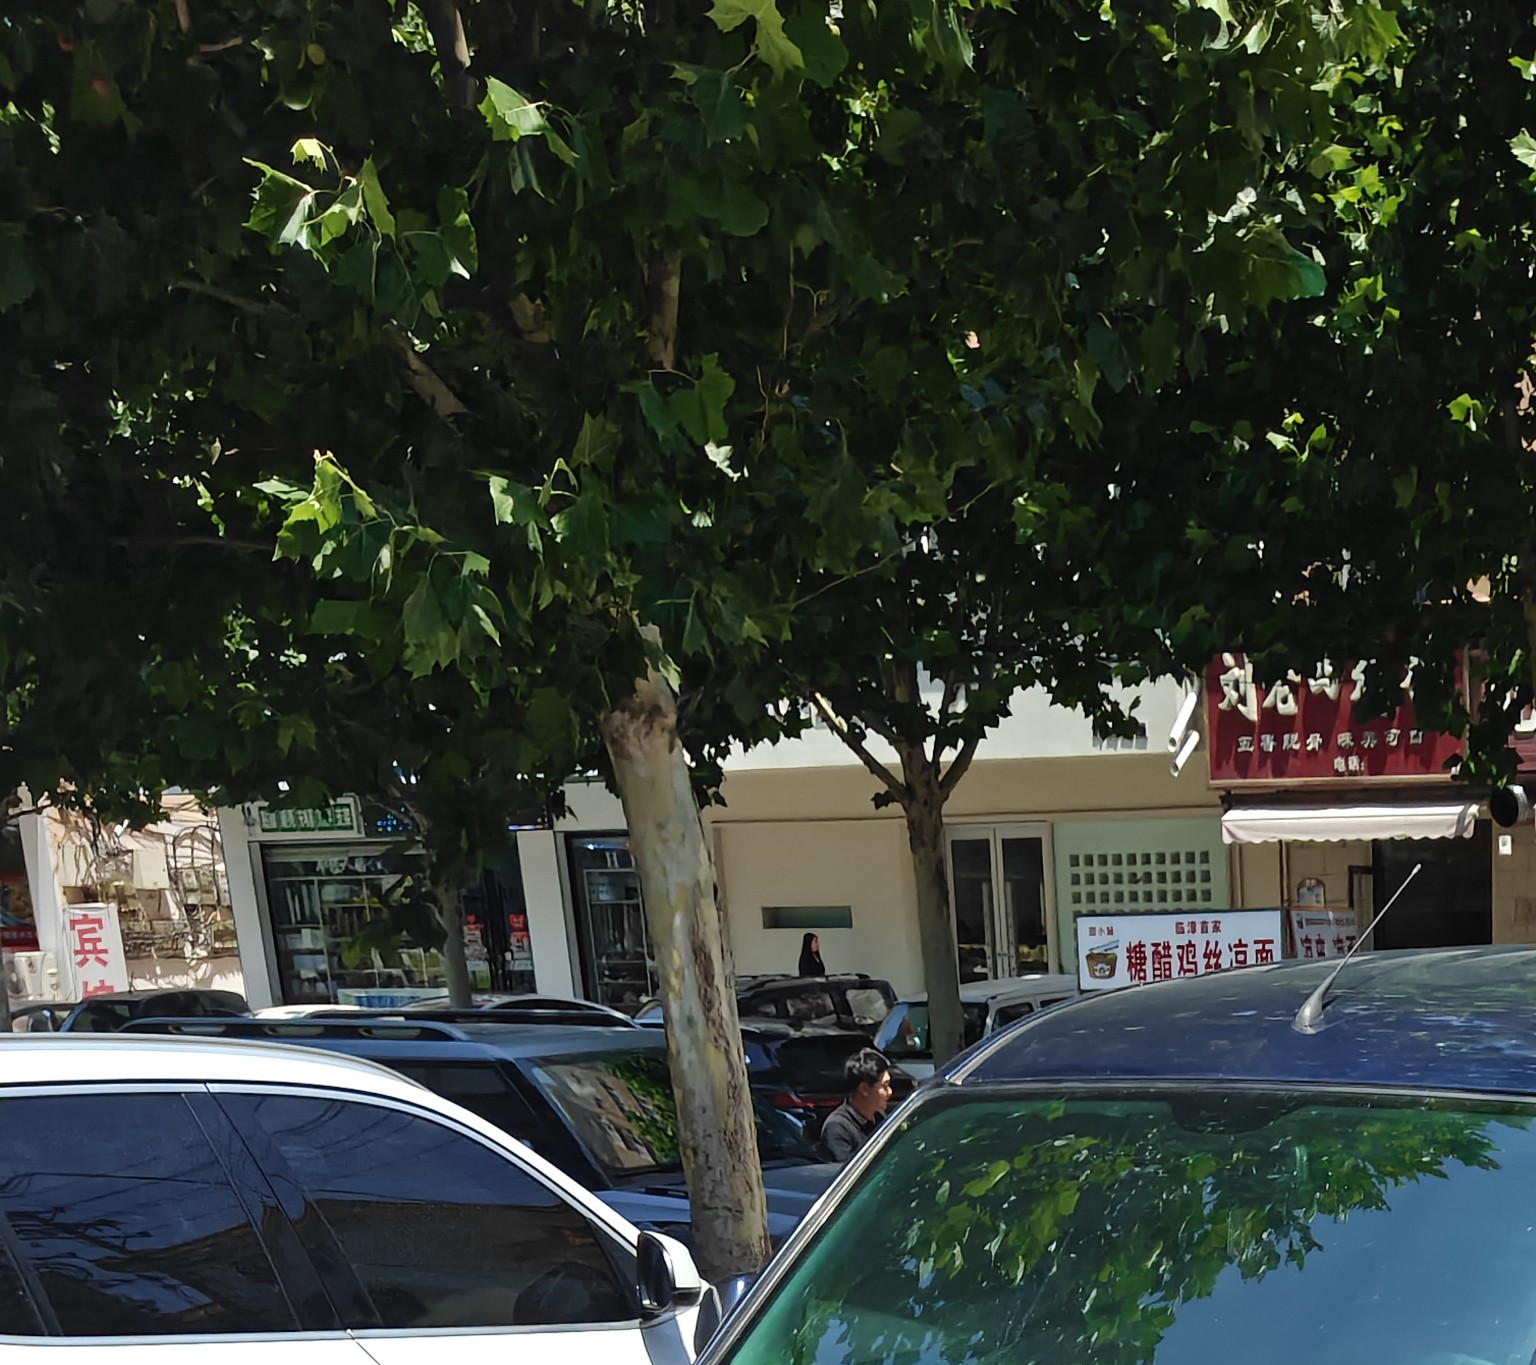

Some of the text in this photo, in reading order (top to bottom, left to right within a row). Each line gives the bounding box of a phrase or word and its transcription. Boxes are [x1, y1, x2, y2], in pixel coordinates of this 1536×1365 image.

[1125, 939, 1275, 982] 糖醋鸡丝凉面
